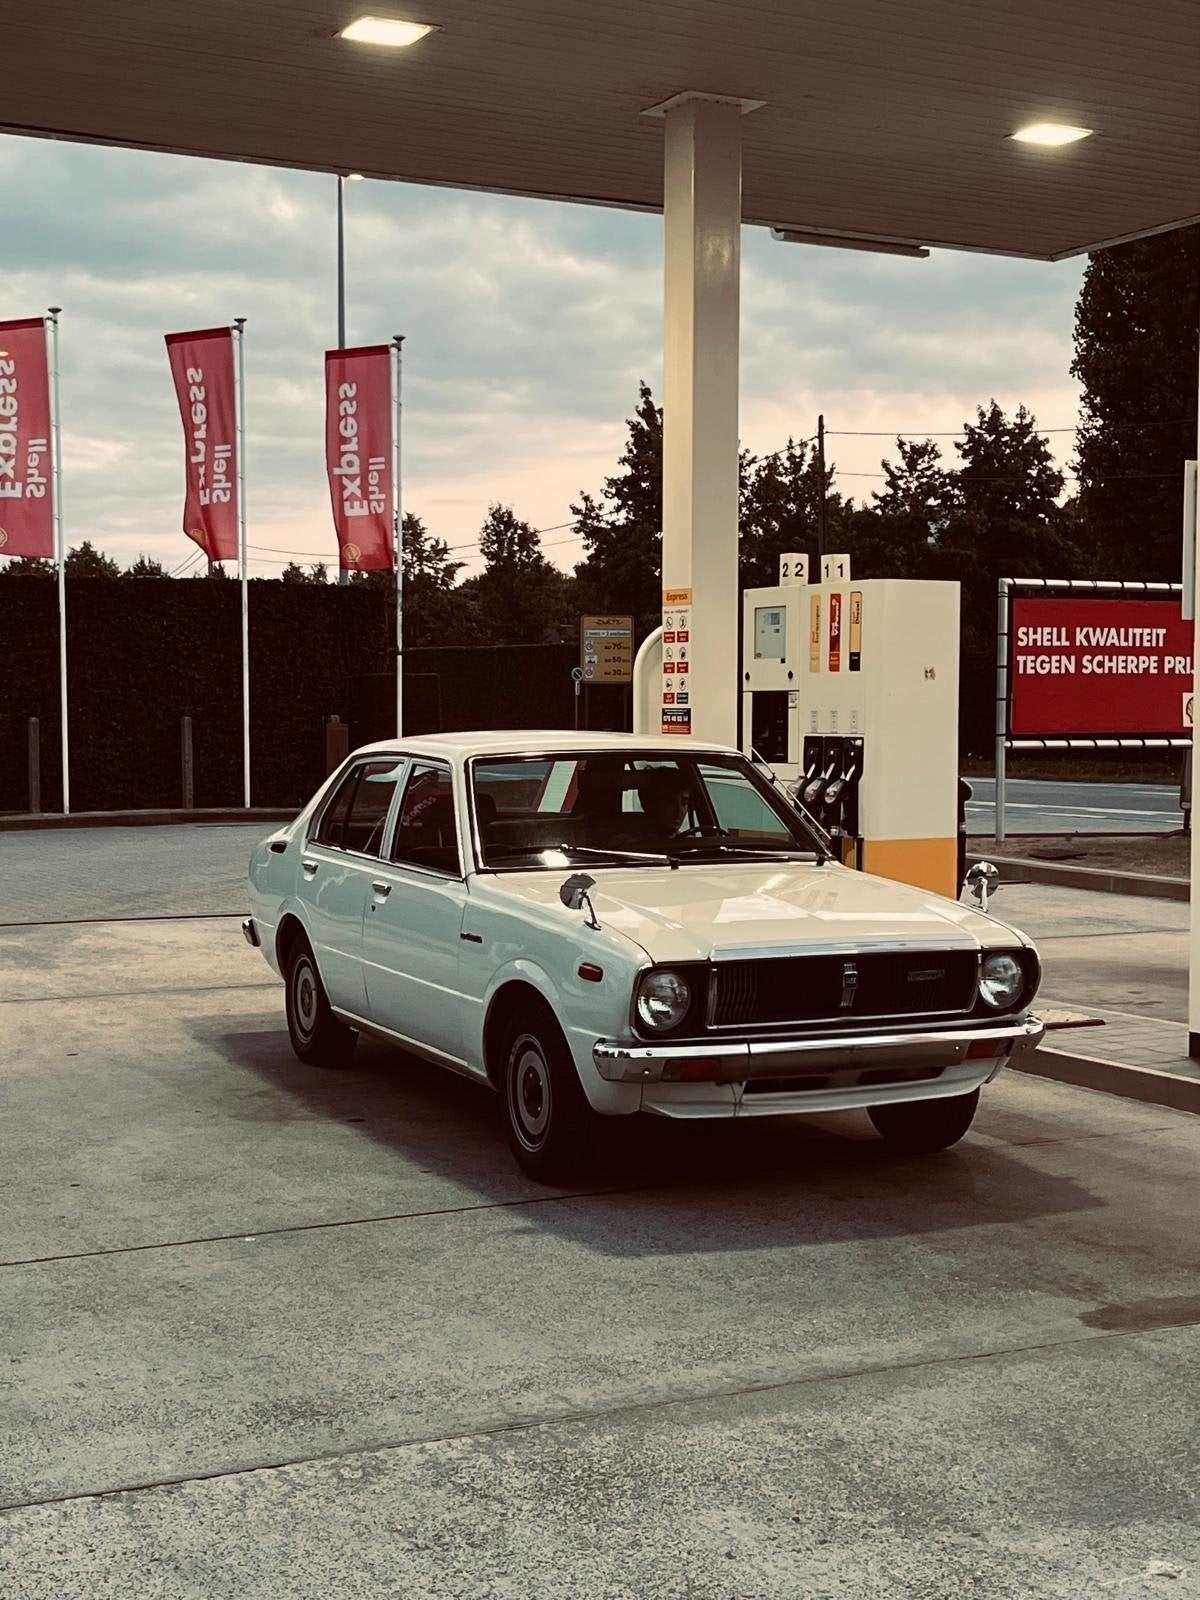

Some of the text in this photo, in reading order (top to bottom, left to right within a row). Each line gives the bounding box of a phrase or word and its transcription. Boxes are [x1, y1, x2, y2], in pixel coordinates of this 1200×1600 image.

[782, 562, 789, 578] 2
[794, 562, 804, 578] 2
[824, 563, 830, 579] 1
[837, 562, 844, 578] 1
[1017, 626, 1166, 647] SHELL KWALITEIT
[1016, 655, 1194, 675] TEGEN SCHERPE PRI
